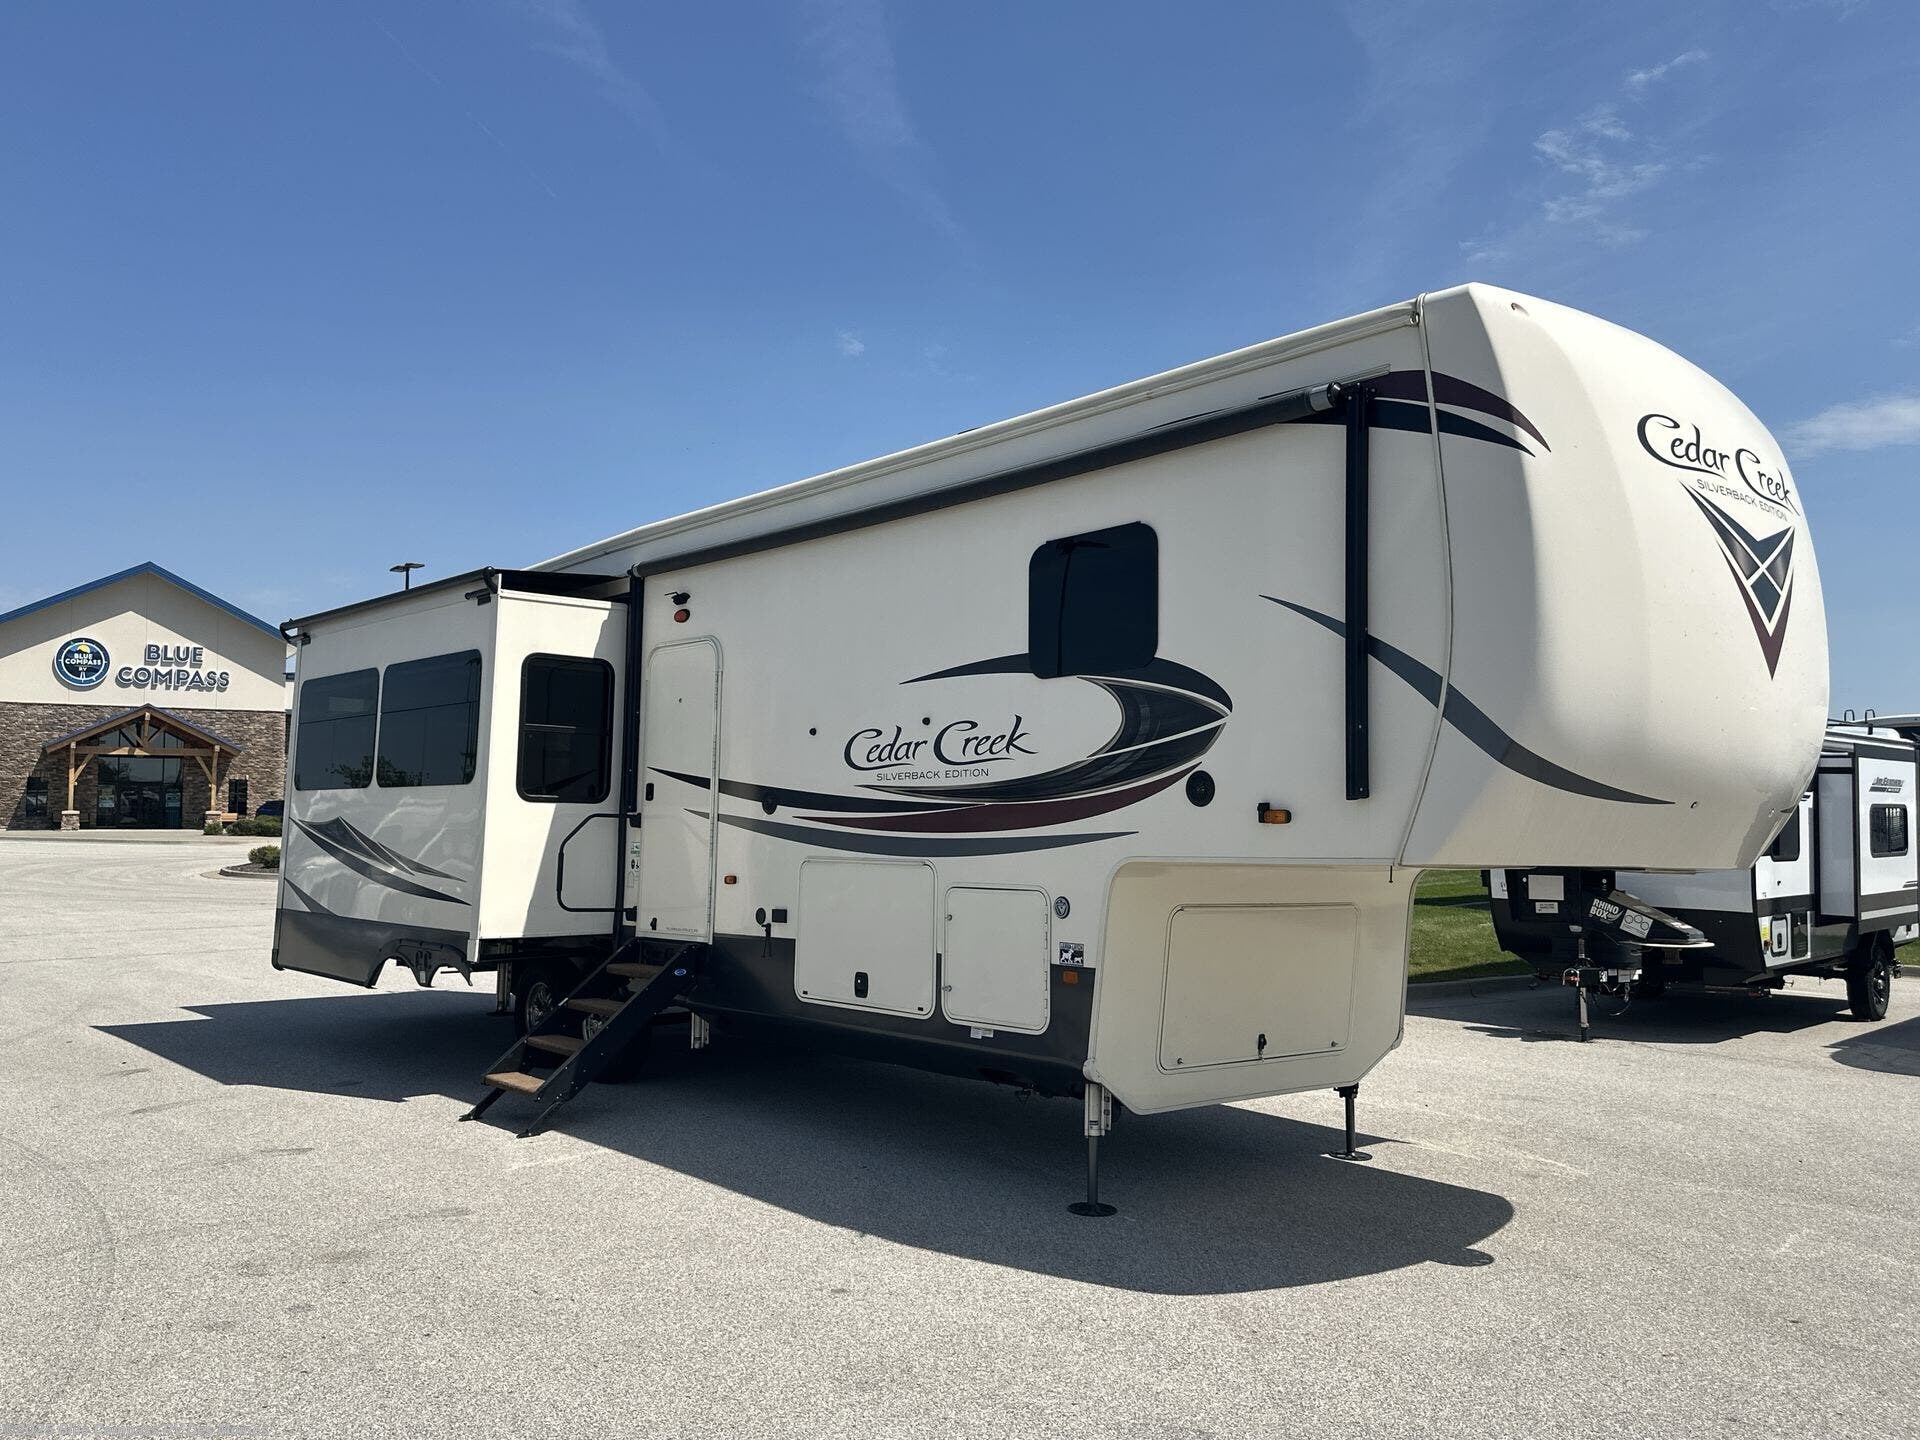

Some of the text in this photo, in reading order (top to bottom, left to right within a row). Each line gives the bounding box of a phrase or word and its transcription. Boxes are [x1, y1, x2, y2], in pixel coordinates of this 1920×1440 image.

[1637, 413, 1800, 517] Cedar Creek
[1696, 478, 1788, 522] SILVERBACK EDITION
[64, 658, 101, 666] COMPASS
[145, 643, 204, 665] BLUE
[117, 666, 230, 689] COMPASS
[844, 714, 1039, 771] Cedar Creek
[876, 768, 989, 781] SILVERBACK EDITION
[1589, 906, 1609, 920] BOX
[1592, 898, 1620, 915] RHINO
